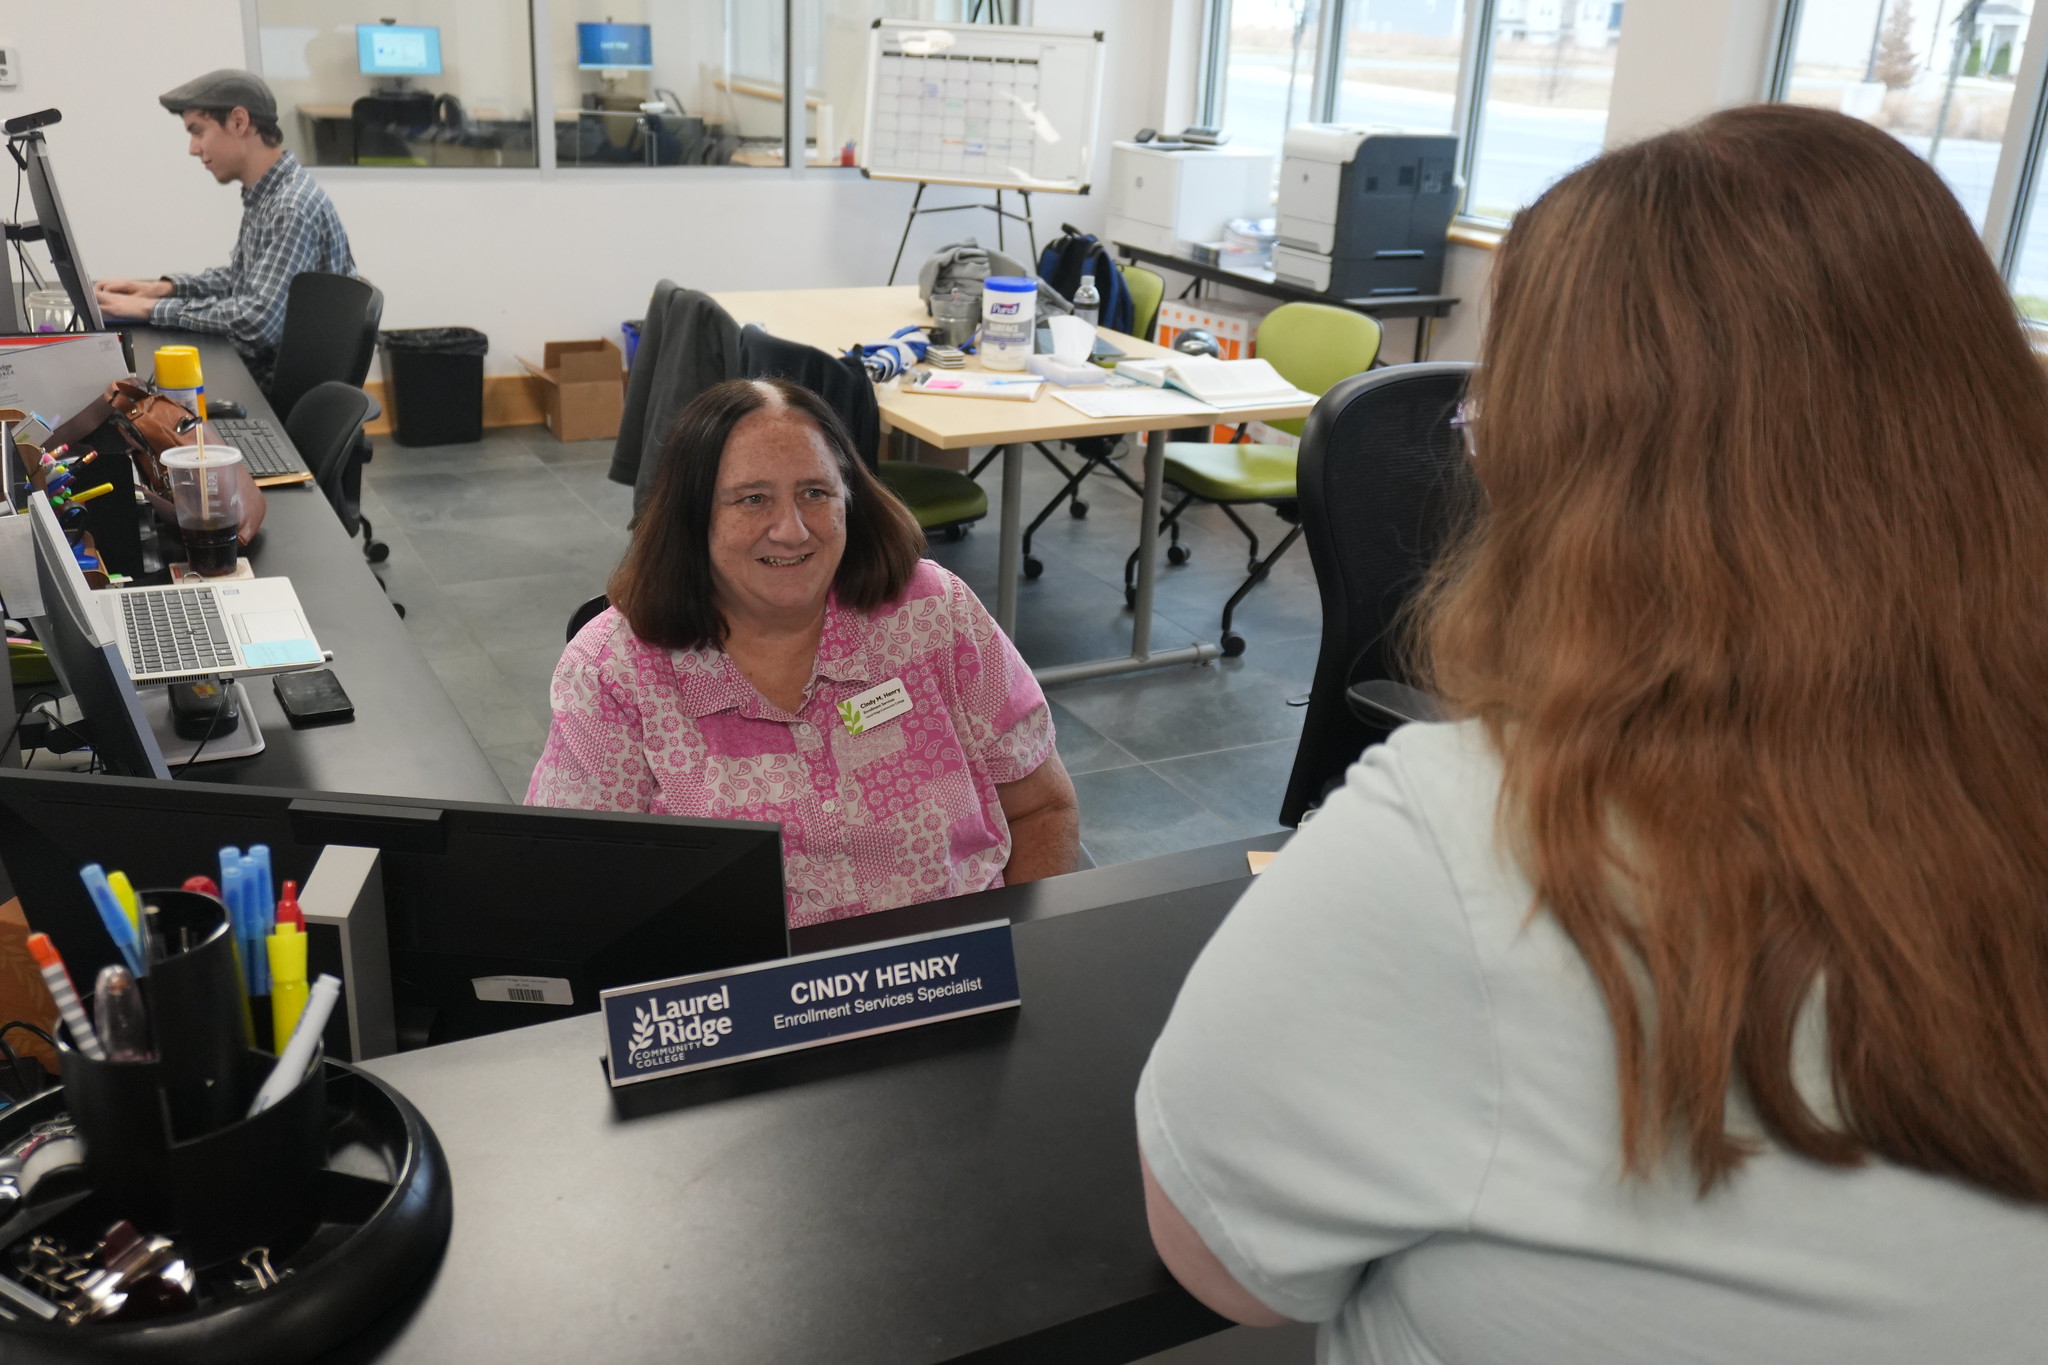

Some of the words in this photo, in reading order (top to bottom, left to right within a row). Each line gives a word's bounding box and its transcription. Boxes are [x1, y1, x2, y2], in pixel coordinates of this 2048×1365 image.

[860, 699, 876, 709] Cindy
[883, 688, 900, 698] Henry
[790, 970, 869, 1004] CINDY
[876, 953, 959, 989] HENRY
[648, 984, 730, 1022] Laurel
[773, 1004, 851, 1029] Enrollment
[854, 991, 914, 1014] Services
[917, 977, 983, 1002] Specialist
[657, 1015, 733, 1047] Ridge
[634, 1041, 702, 1060] COMMUNITY
[636, 1053, 685, 1069] COLLEGE
